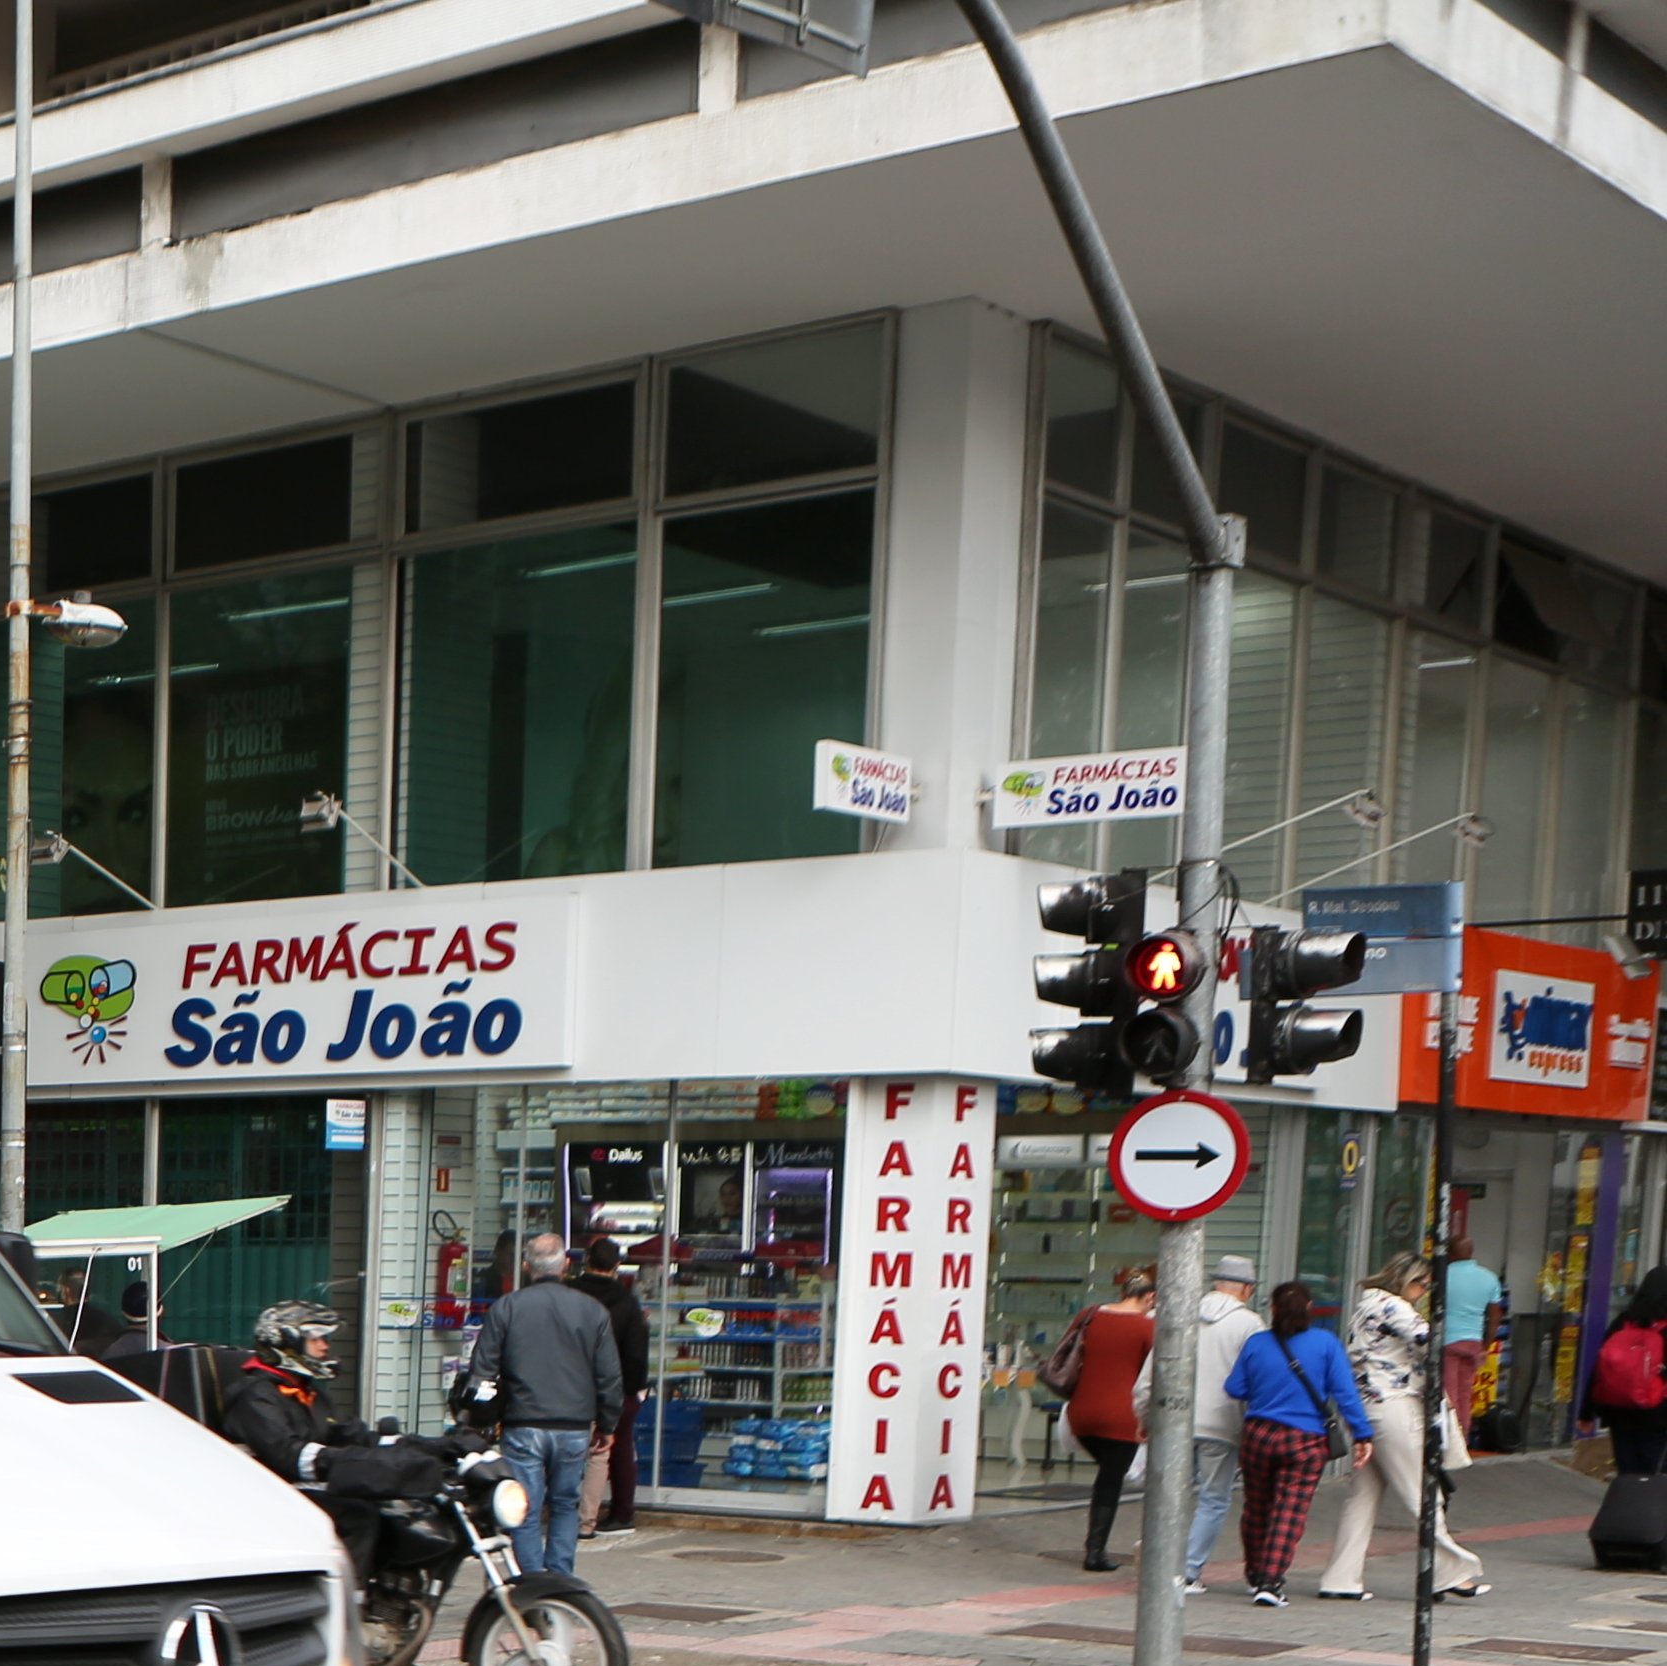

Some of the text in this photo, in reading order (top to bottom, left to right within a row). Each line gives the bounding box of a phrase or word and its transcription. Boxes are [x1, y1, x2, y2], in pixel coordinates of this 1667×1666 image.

[206, 685, 304, 727] DESCUBRA
[223, 721, 283, 759] PODER
[206, 751, 319, 782] DAS SOBRANCELHAS
[852, 757, 908, 785] FARMÁCIAS
[1053, 756, 1179, 787] FARMÁCIAS
[850, 777, 907, 814] São João
[1046, 778, 1179, 815] São João
[205, 810, 264, 831] BROW
[181, 921, 520, 990] FARMÁCIAS
[164, 977, 523, 1068] São João
[1527, 1049, 1584, 1078] express
[608, 1147, 644, 1163] Dailus
[127, 1256, 142, 1272] 01
[860, 1082, 916, 1511] FARMÁCIA
[928, 1085, 979, 1512] FARMÁCIA
